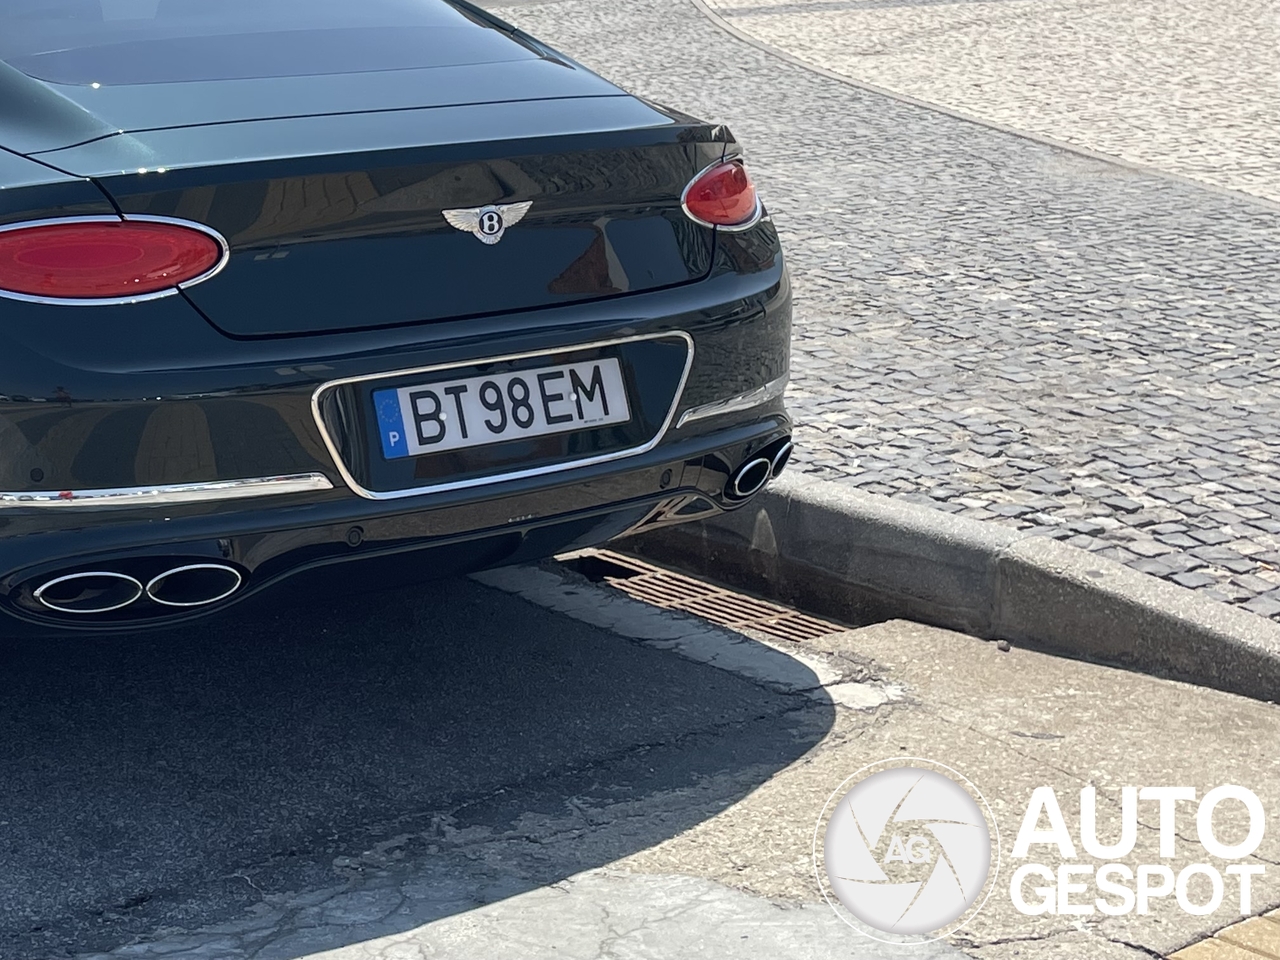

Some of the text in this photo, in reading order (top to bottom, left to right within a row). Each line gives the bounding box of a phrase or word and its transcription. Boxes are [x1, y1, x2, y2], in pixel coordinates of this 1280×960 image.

[482, 212, 500, 233] B
[409, 365, 610, 446] BT 98 EM
[389, 431, 400, 447] P
